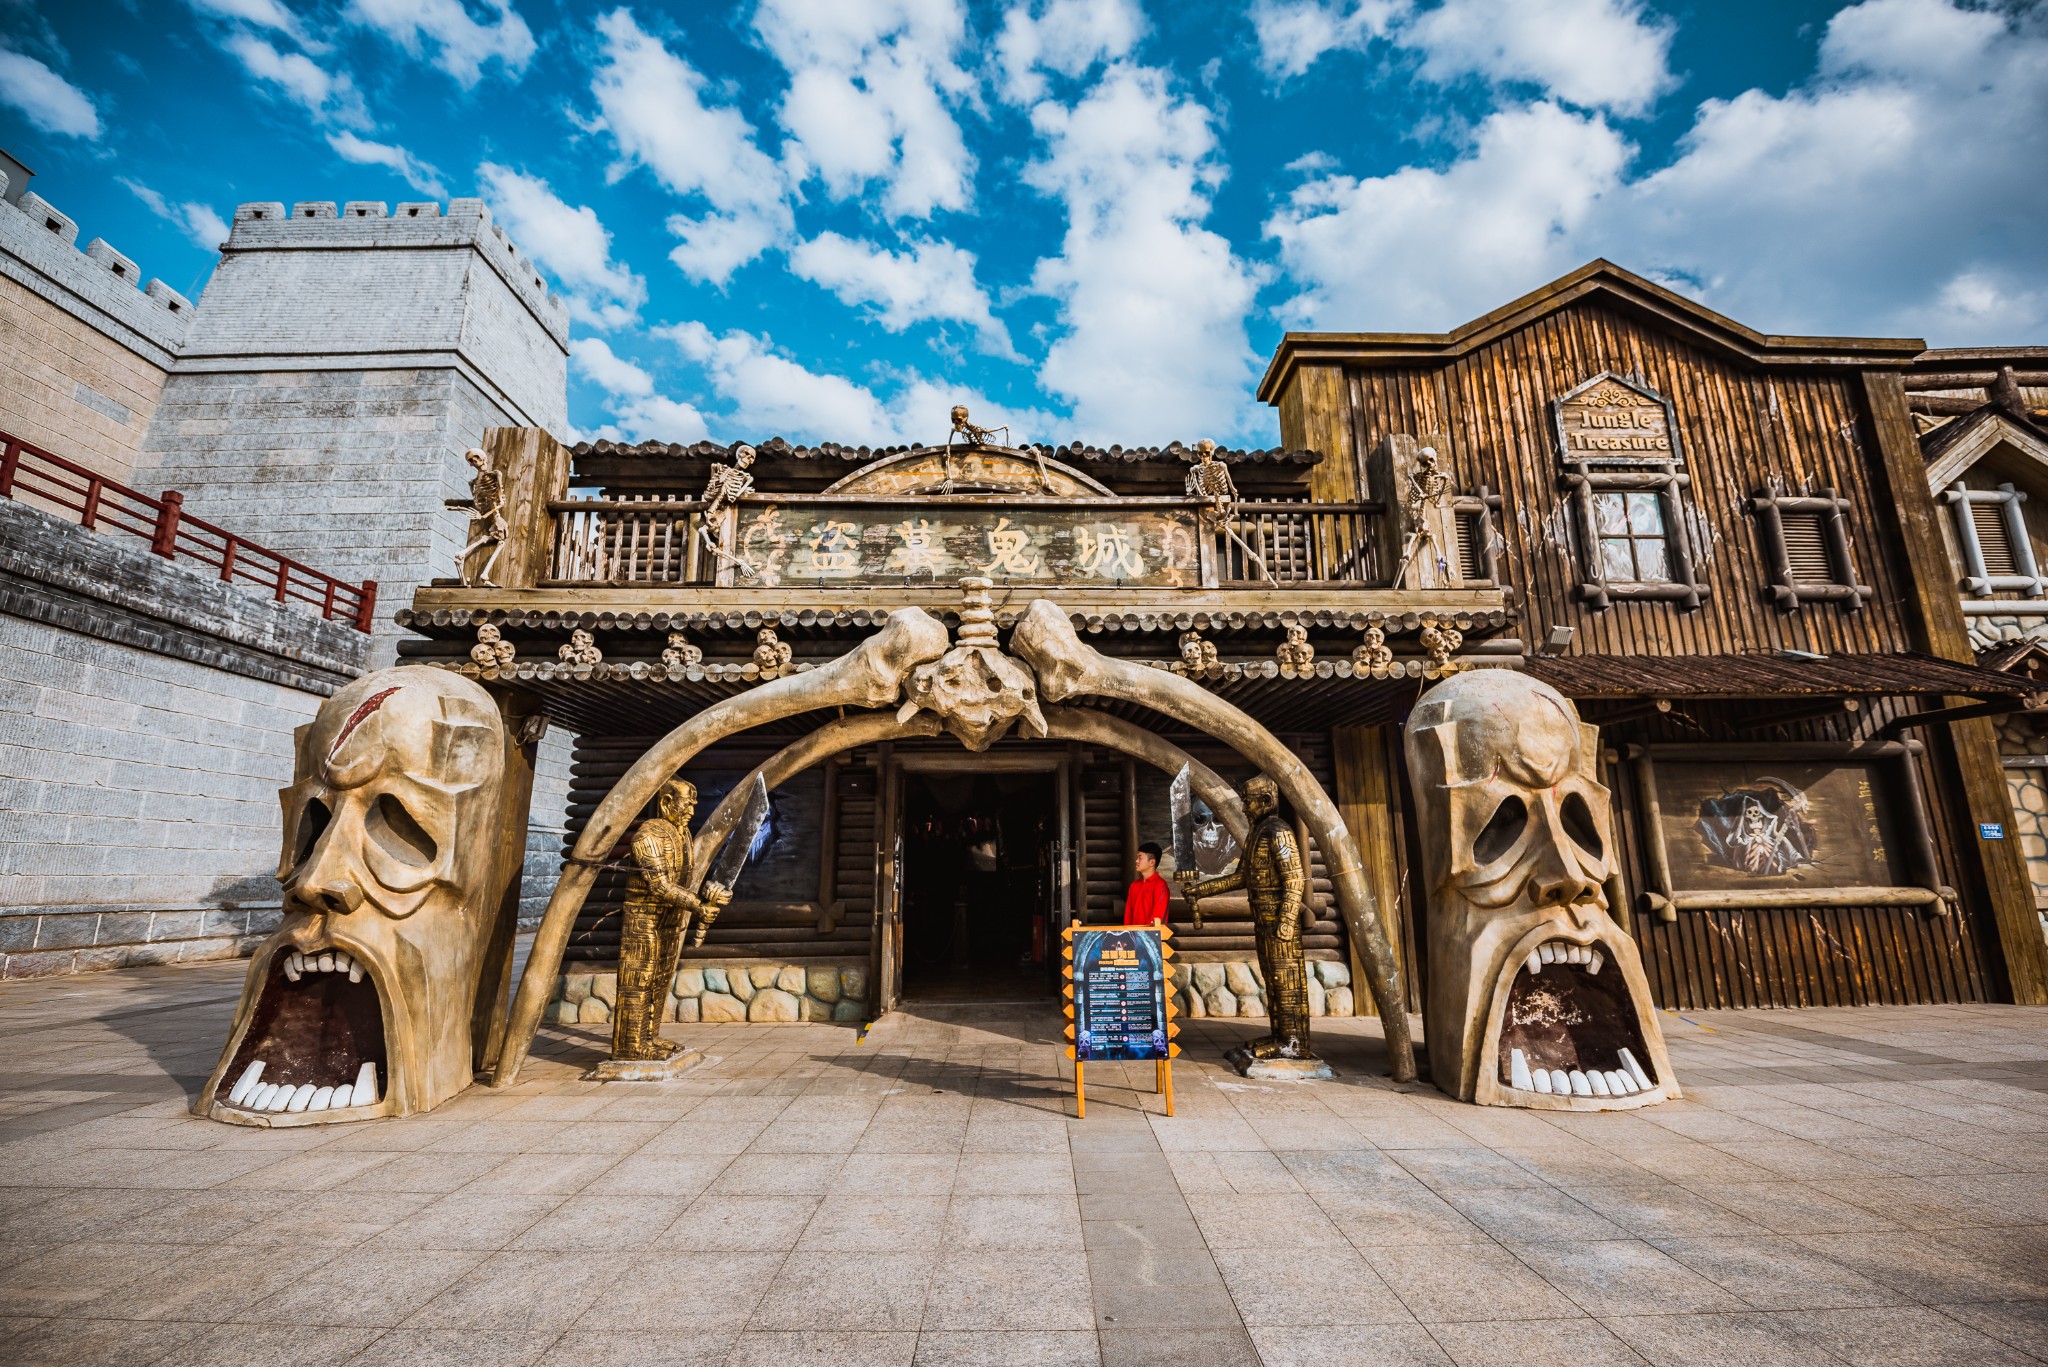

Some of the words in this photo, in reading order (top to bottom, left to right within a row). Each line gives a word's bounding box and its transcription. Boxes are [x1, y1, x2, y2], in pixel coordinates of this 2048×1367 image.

[1580, 410, 1651, 429] Jungle
[1571, 432, 1669, 450] Treasure
[808, 517, 1144, 578] 盗墓鬼城
